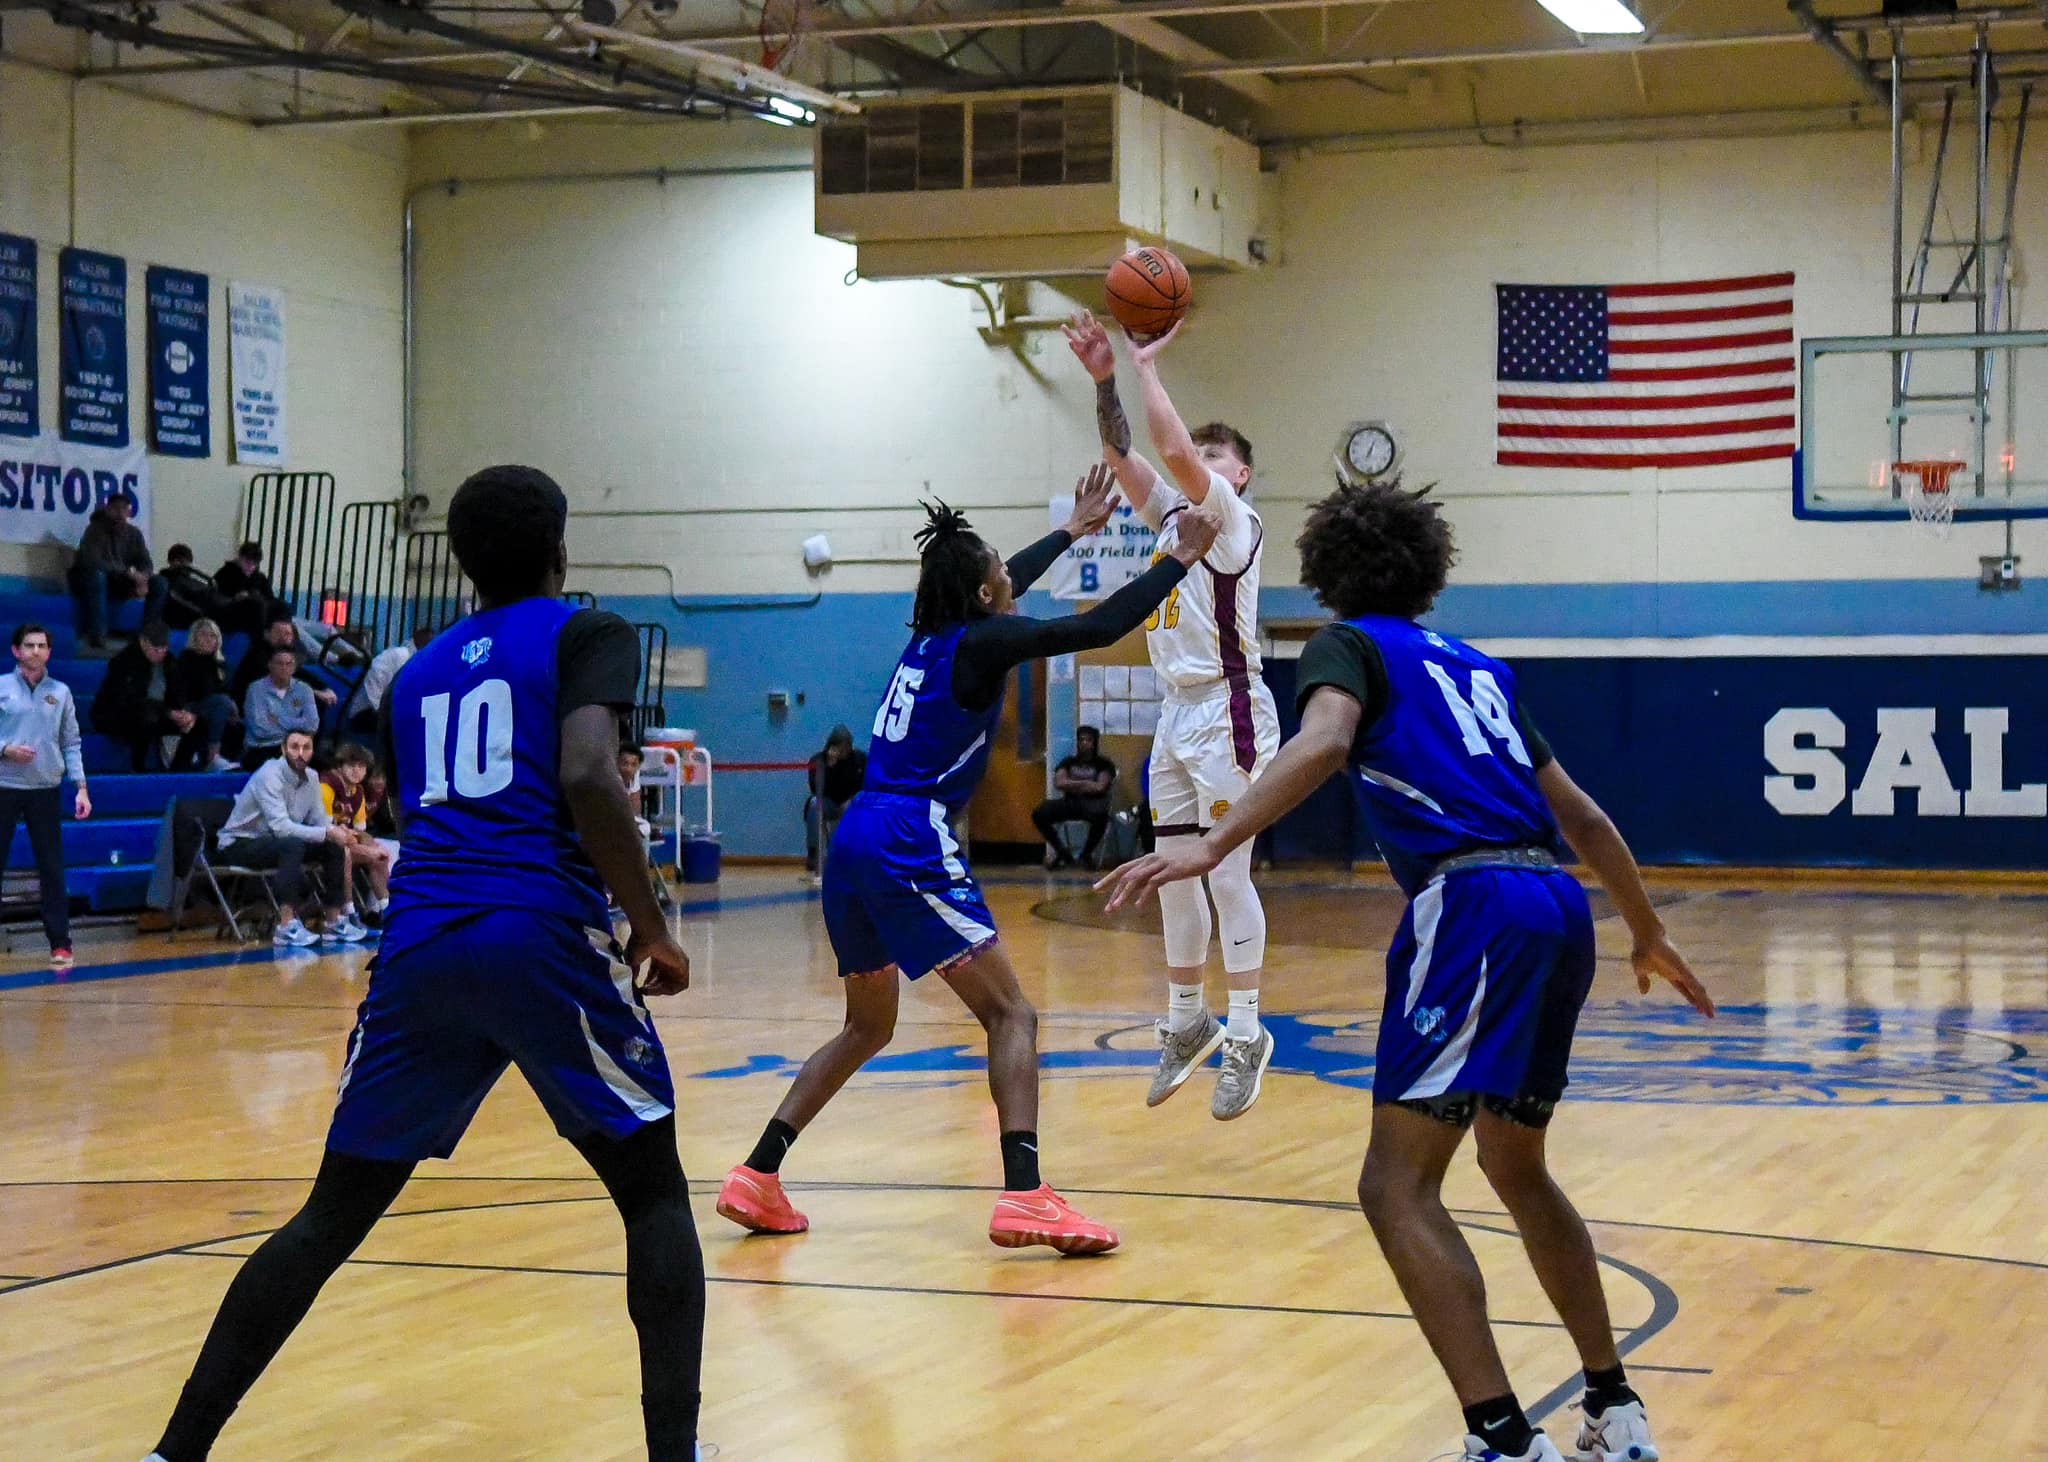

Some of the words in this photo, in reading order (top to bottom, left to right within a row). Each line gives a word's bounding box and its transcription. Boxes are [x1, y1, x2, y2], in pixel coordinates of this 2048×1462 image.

[1081, 563, 1099, 592] B
[1100, 546, 1135, 558] Field
[419, 678, 515, 808] 10
[872, 662, 926, 743] 15
[1422, 660, 1534, 769] 14
[1763, 706, 2048, 818] SAL
